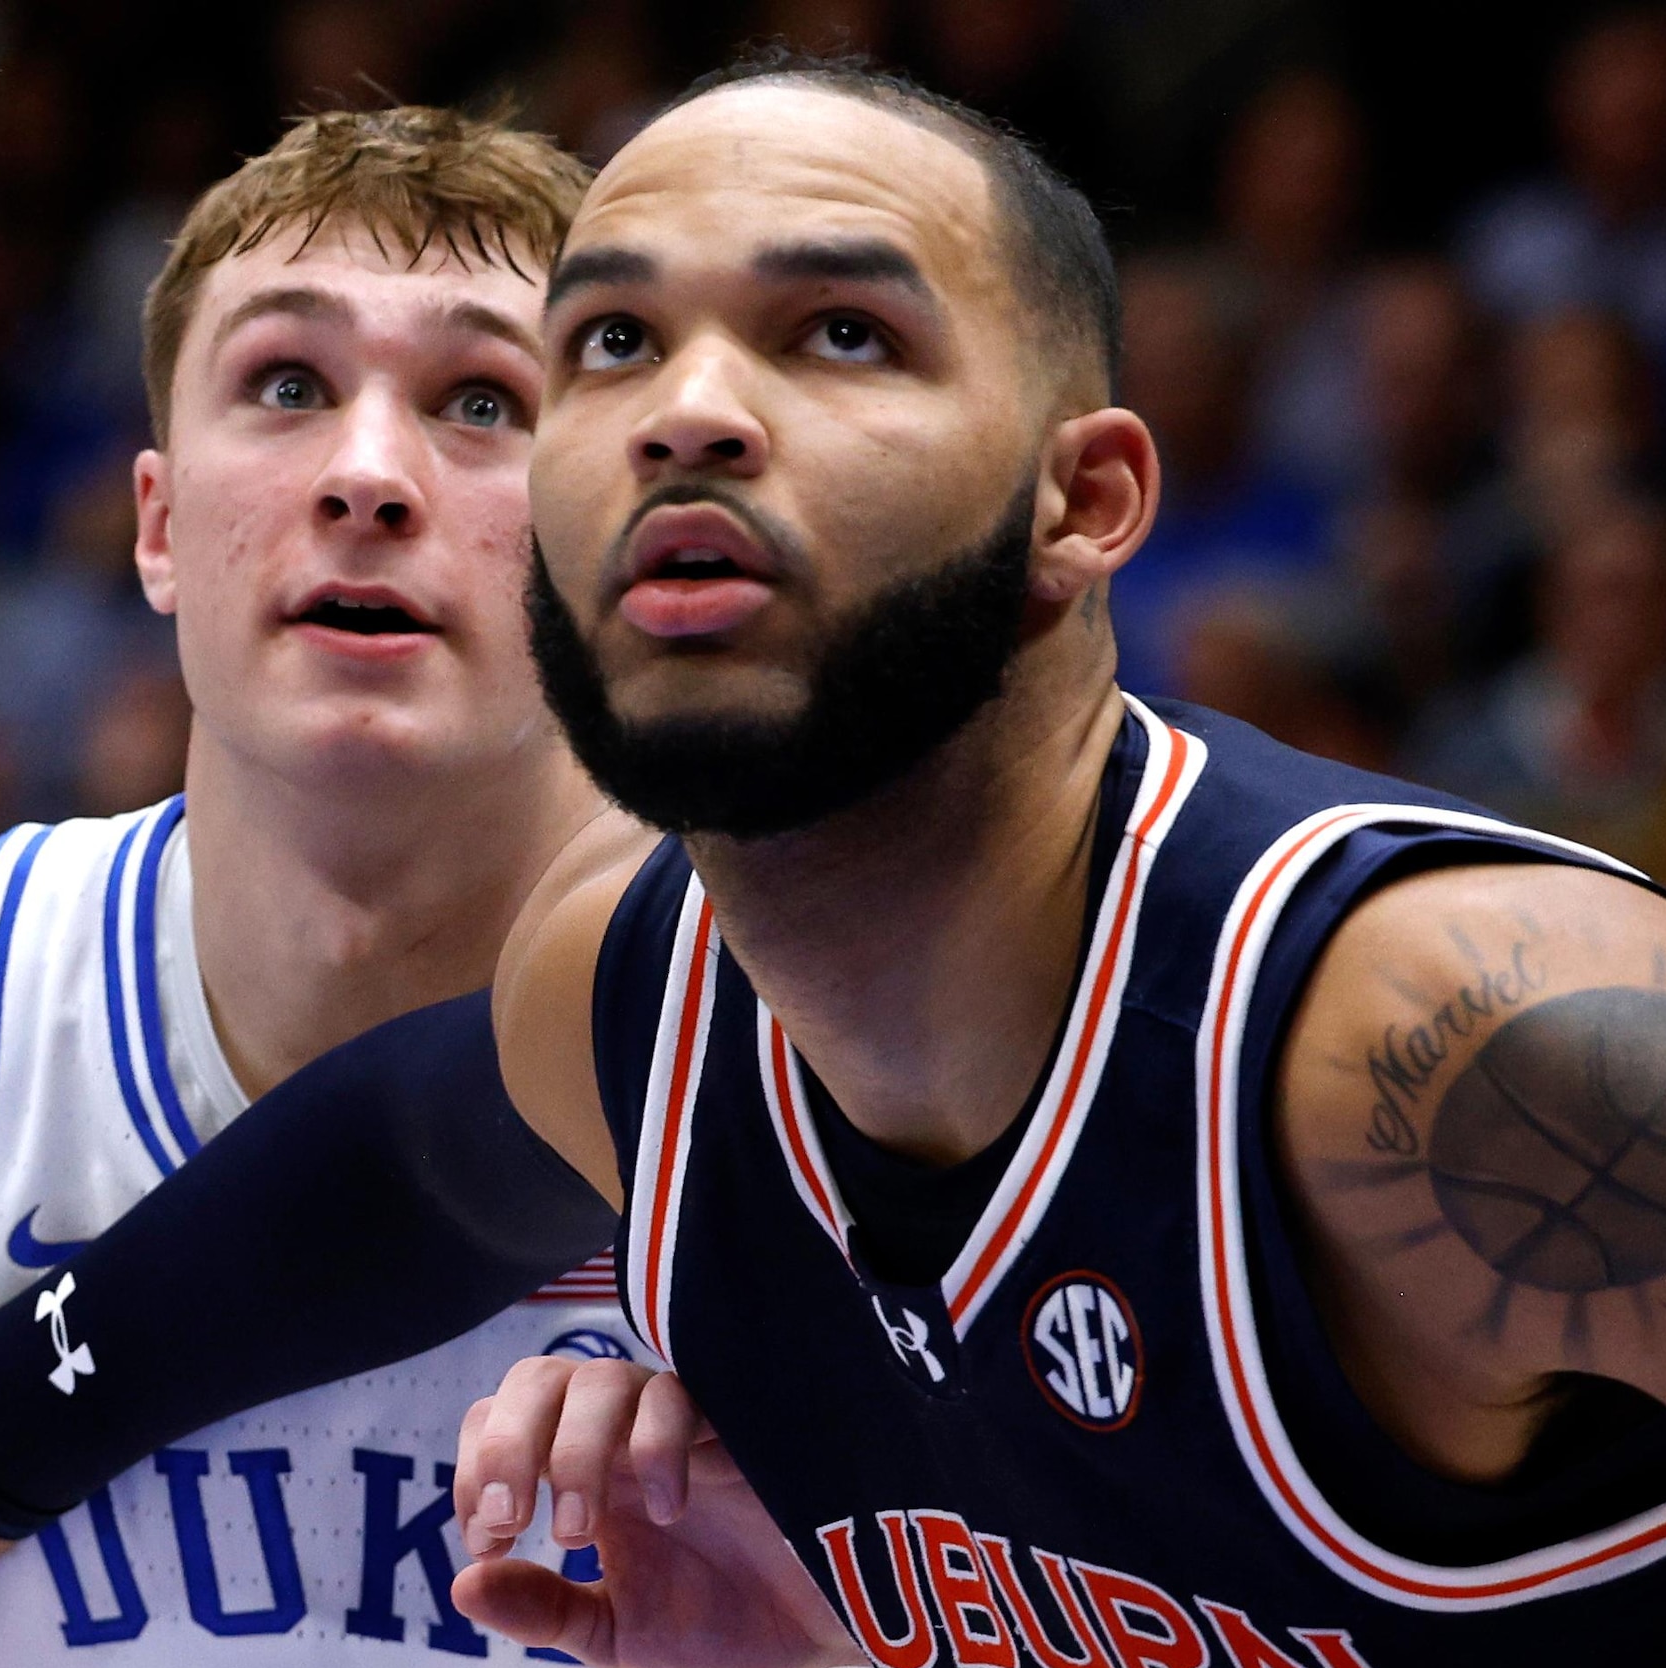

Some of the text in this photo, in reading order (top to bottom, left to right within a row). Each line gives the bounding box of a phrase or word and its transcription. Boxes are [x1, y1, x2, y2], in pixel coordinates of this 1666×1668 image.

[1365, 941, 1547, 1156] Marvel
[1034, 1283, 1134, 1418] SEC
[36, 1447, 605, 1667] DUK
